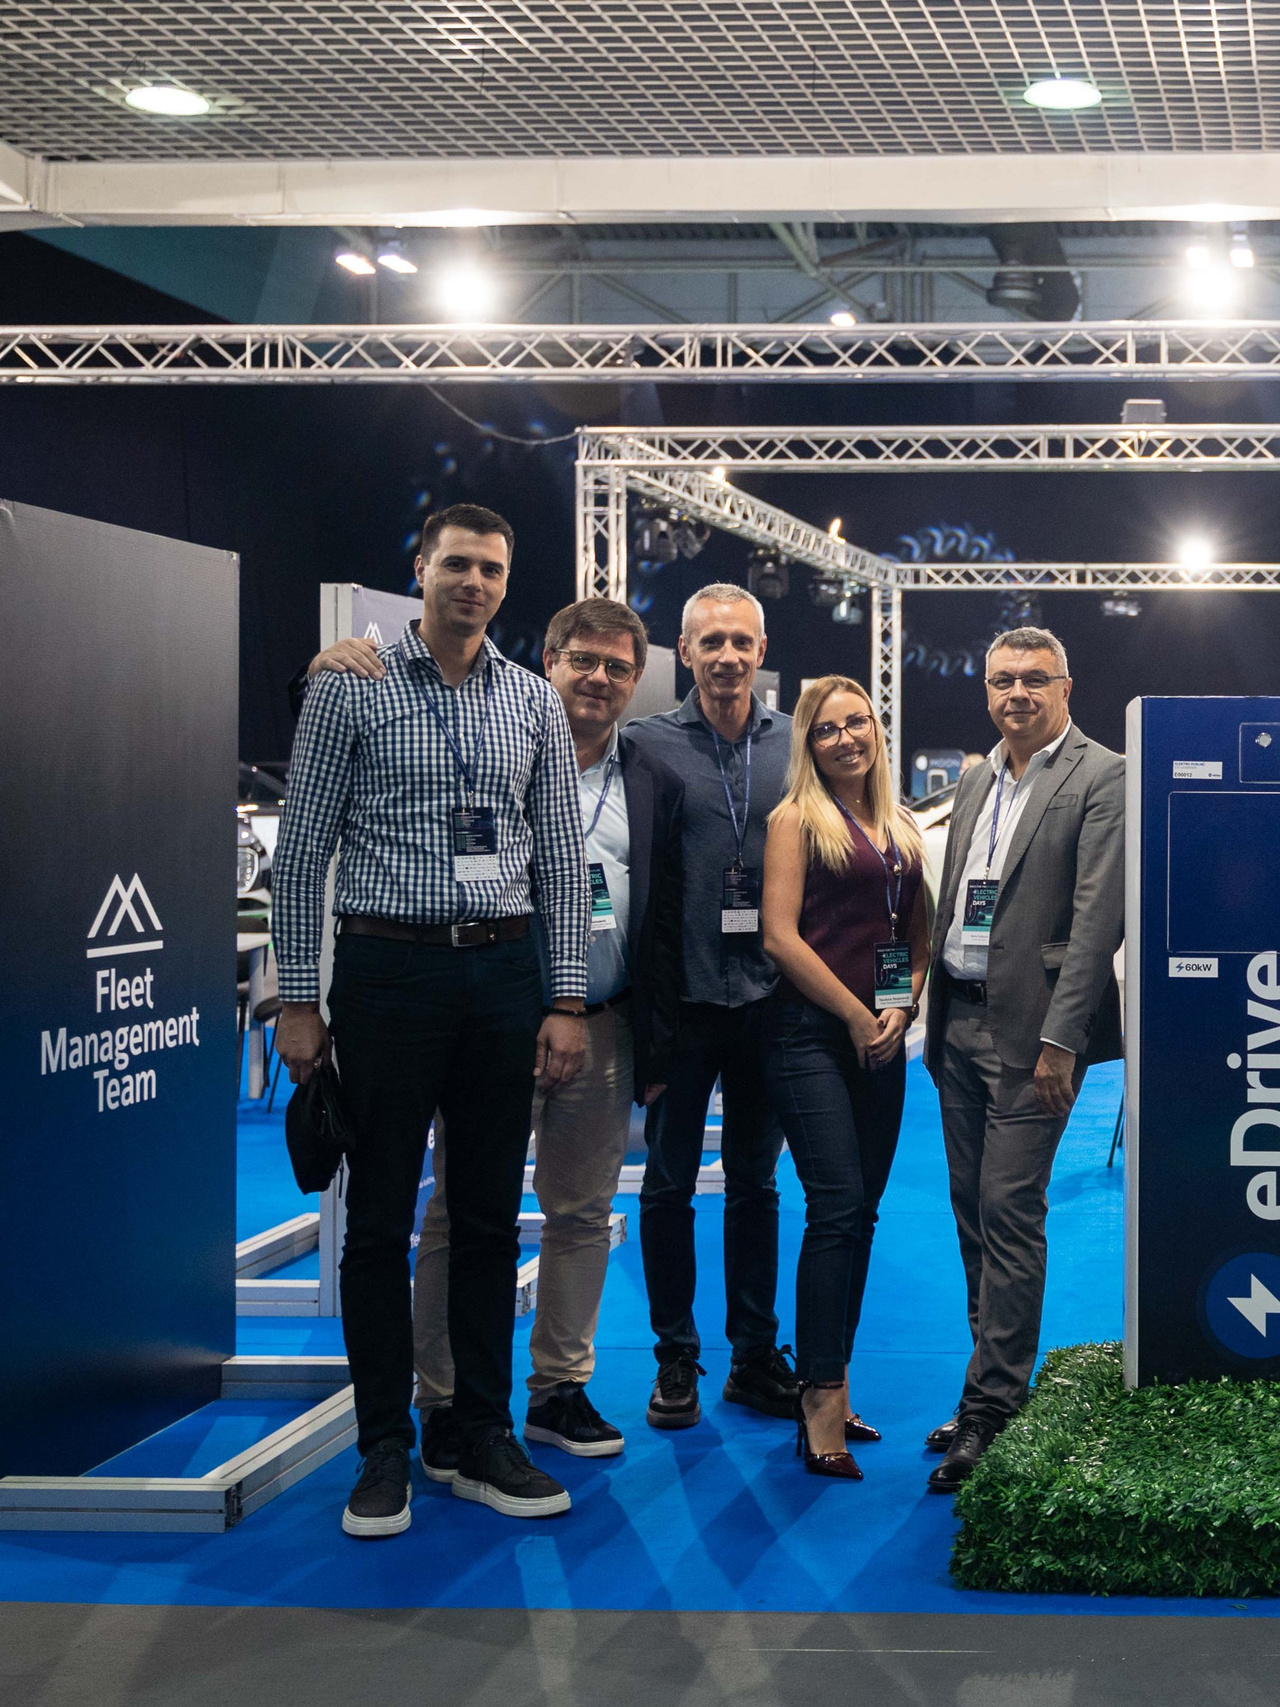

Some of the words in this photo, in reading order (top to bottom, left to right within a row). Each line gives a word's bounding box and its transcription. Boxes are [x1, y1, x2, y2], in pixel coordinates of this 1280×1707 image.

[1185, 963, 1212, 971] 60kW
[96, 968, 154, 1013] Fleet
[41, 1006, 200, 1076] Management
[93, 1069, 157, 1113] Team
